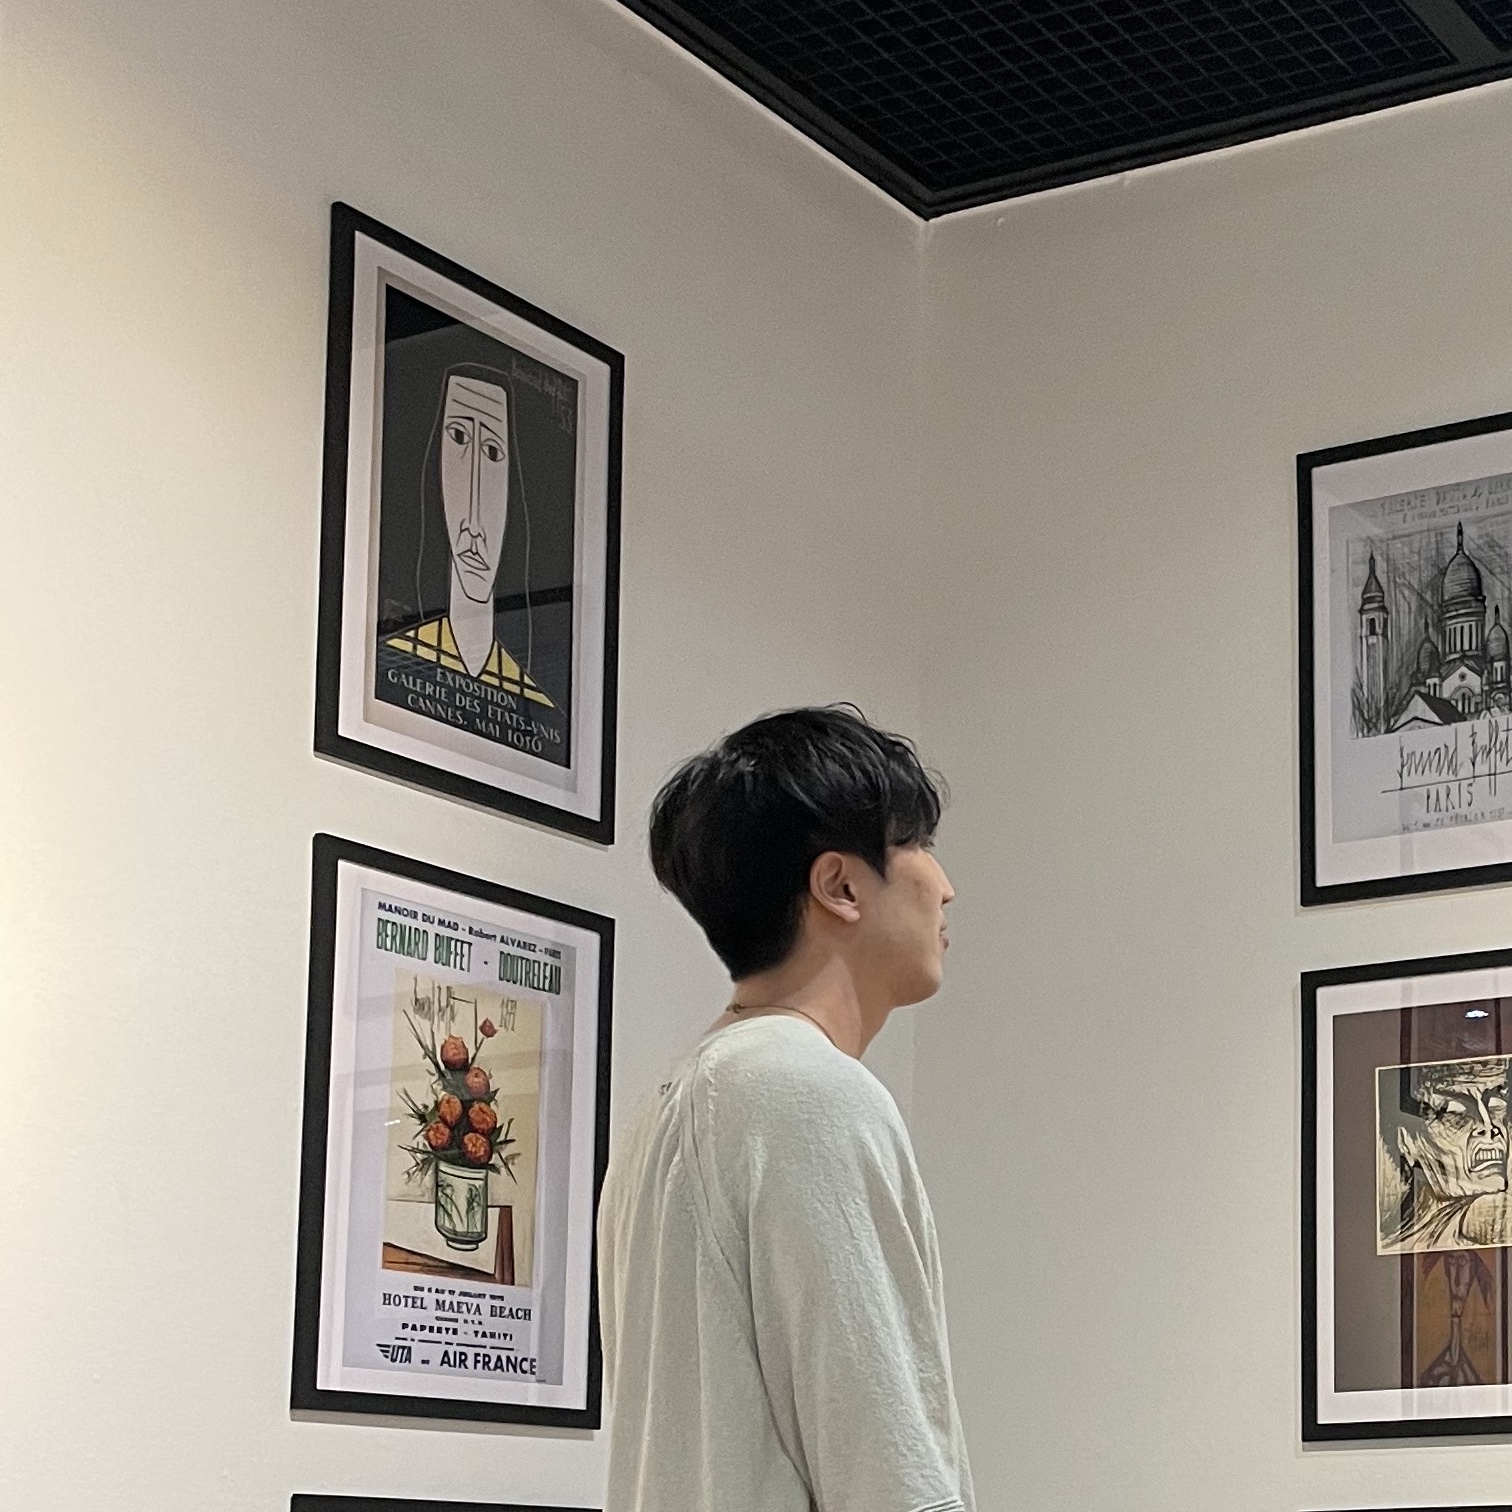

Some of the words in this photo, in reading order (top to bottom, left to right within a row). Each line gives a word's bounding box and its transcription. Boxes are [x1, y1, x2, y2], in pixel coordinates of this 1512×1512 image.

[388, 669, 448, 700] GALERIE
[456, 694, 480, 713] DES
[436, 668, 517, 710] EXPOSITION
[475, 718, 500, 738] MAI
[1426, 782, 1474, 813] PARIS
[378, 901, 418, 921] MANOIR
[422, 914, 435, 924] DU
[468, 926, 497, 942] Robert
[376, 918, 428, 961] BERNARD
[434, 932, 472, 972] BUFFET
[382, 1293, 428, 1310] HOTEL
[435, 1299, 482, 1316] MAEVA
[490, 1305, 532, 1321] BEACH
[474, 1330, 513, 1341] TAHITI
[389, 1345, 412, 1364] UTA
[440, 1350, 468, 1369] AIR
[474, 1354, 536, 1375] FRANCE
